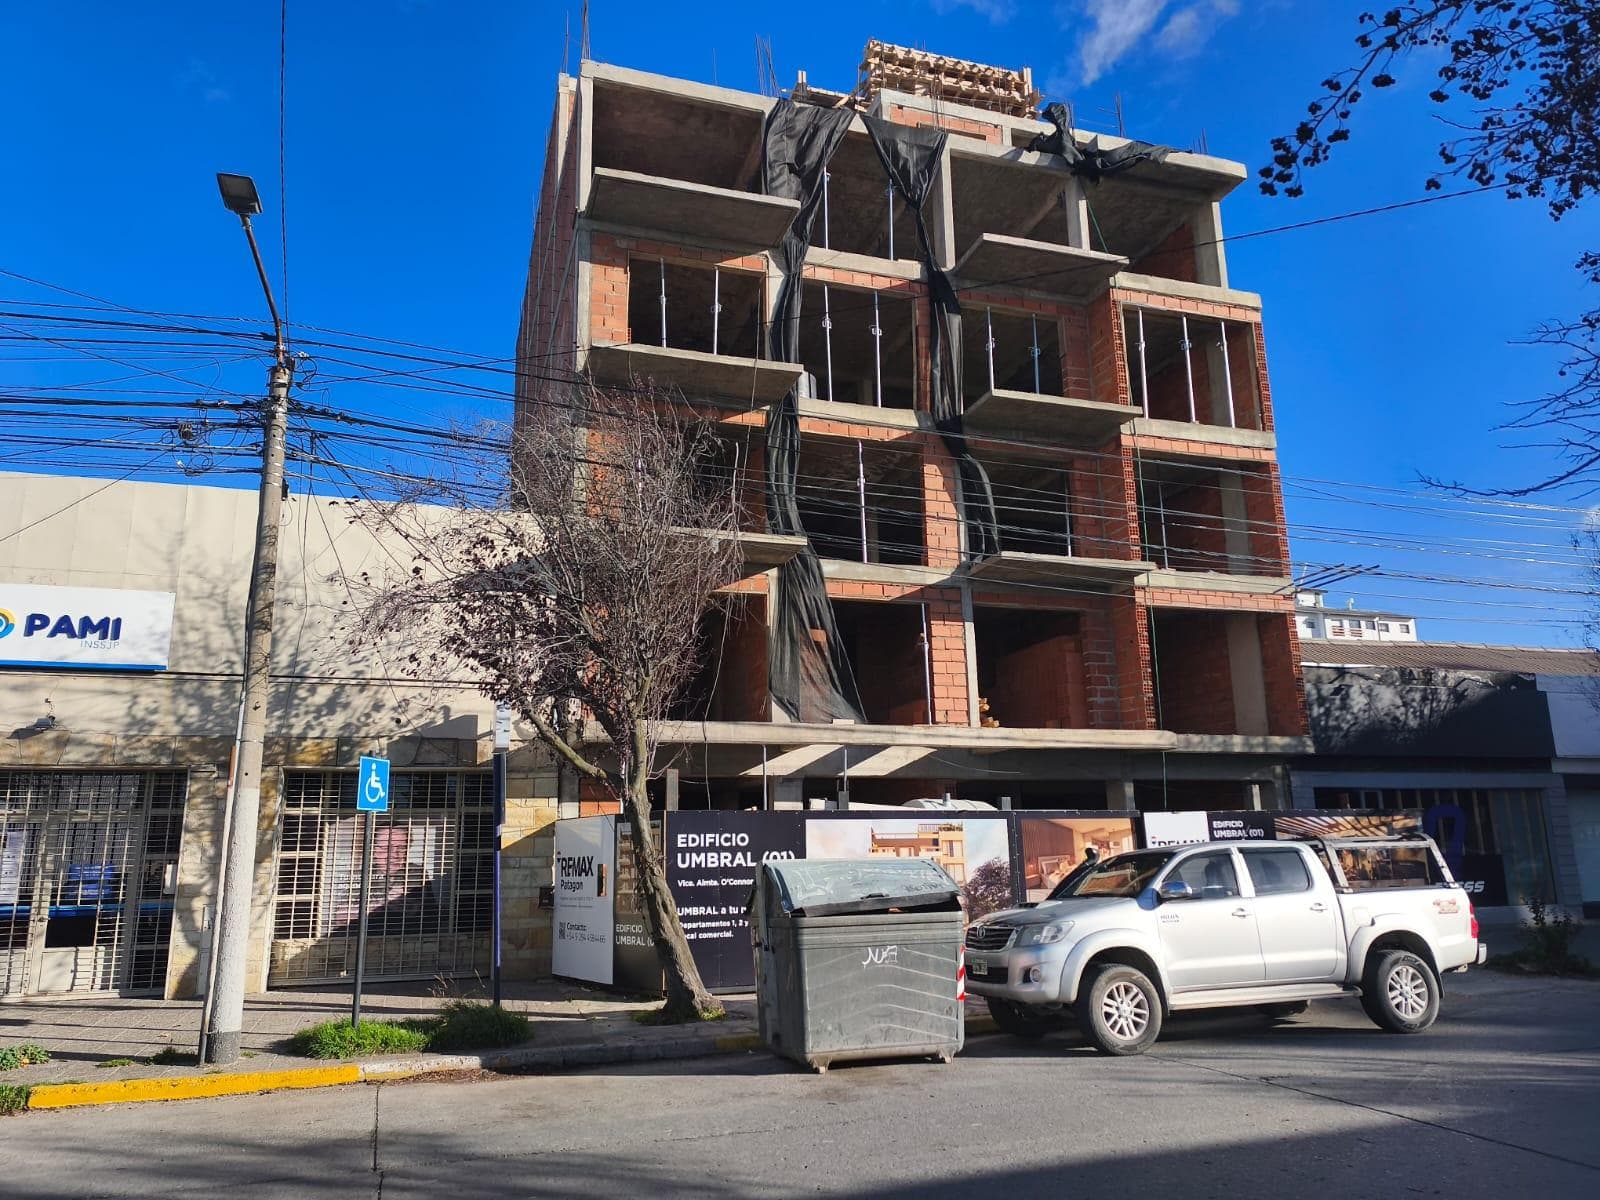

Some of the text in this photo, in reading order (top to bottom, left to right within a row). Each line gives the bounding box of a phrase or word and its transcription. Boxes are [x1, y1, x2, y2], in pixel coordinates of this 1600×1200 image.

[24, 613, 122, 641] PAMI
[80, 640, 120, 650] INSSJP
[1212, 820, 1244, 829] EDIFICIO
[1213, 829, 1248, 839] UMBRAL
[677, 833, 750, 848] EDIFICIO
[677, 851, 757, 869] UMBRAL
[720, 878, 755, 886] O'Connor
[677, 906, 719, 916] UMBRAL
[720, 907, 727, 915] a
[729, 905, 739, 915] tu
[615, 924, 644, 934] EDIFICIO
[615, 936, 646, 946] UMBRAL
